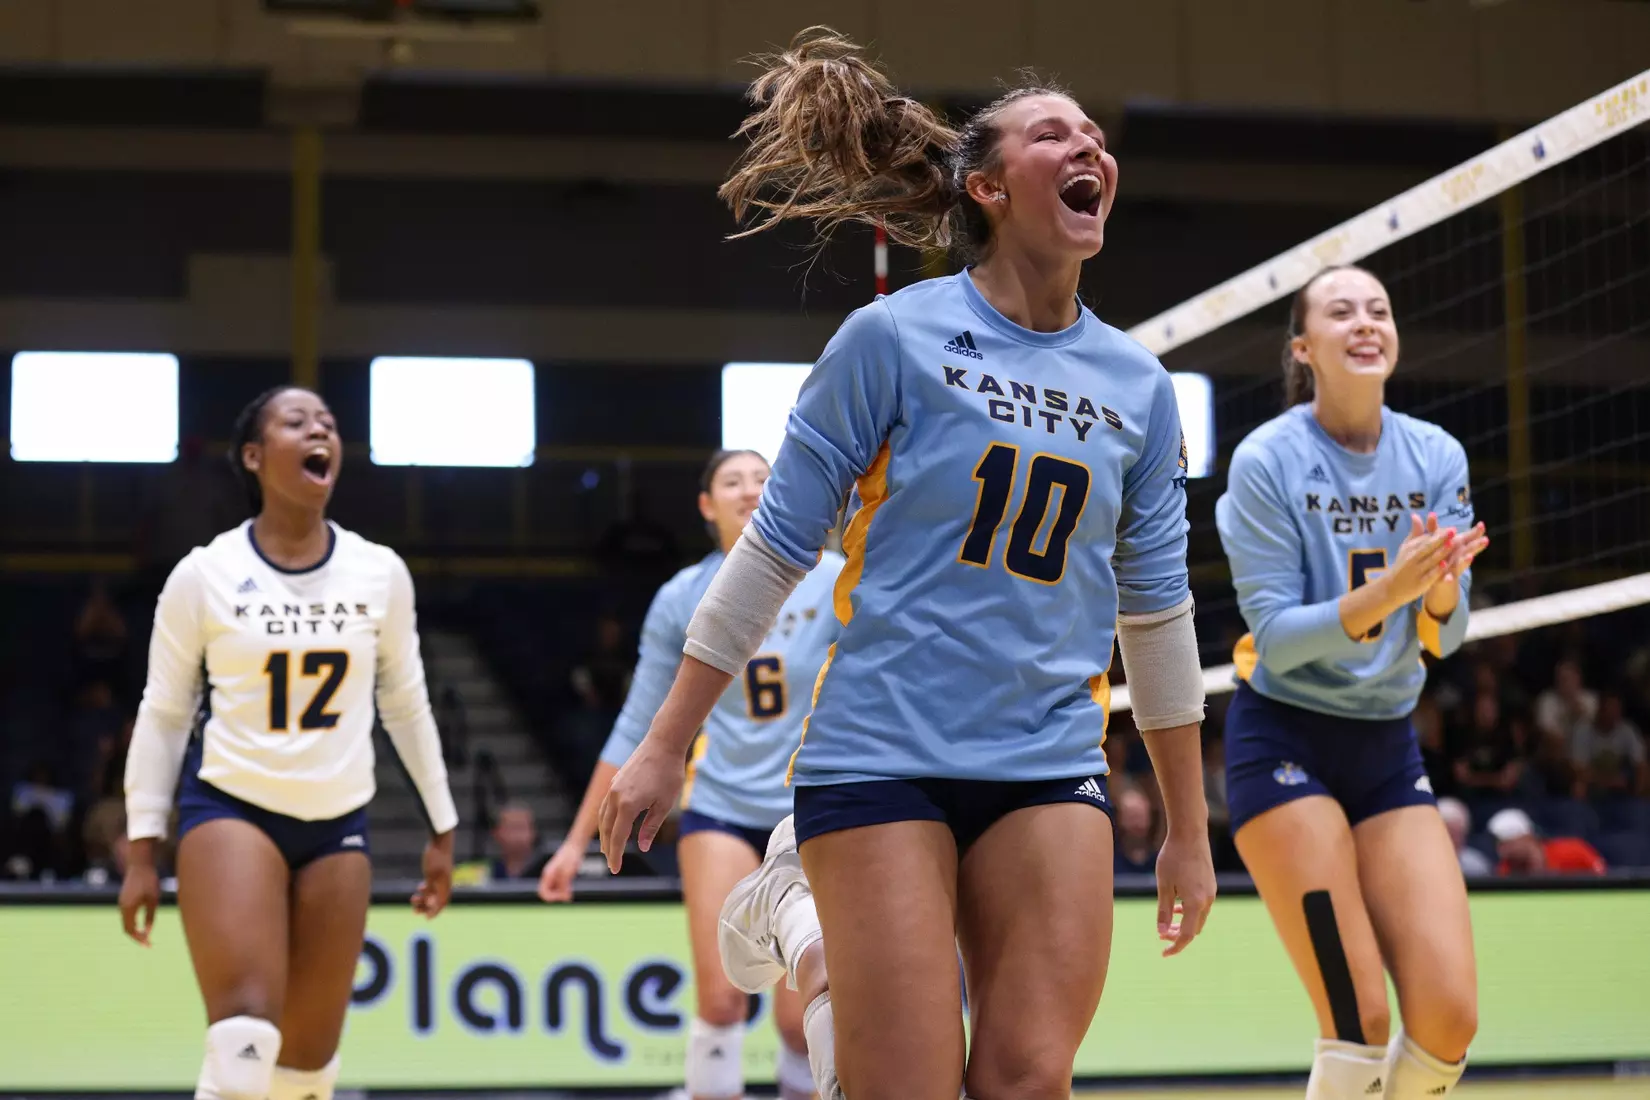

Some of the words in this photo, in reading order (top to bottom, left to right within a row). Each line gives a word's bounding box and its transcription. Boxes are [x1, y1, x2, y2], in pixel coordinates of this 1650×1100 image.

[943, 345, 983, 360] adidas
[942, 365, 1123, 431] KANSAS
[988, 398, 1093, 442] CITY
[956, 440, 1093, 586] 10
[1306, 492, 1426, 514] KANSAS
[1334, 514, 1399, 534] CITY
[266, 620, 345, 636] CITY
[262, 649, 350, 732] 12
[744, 654, 788, 721] 6
